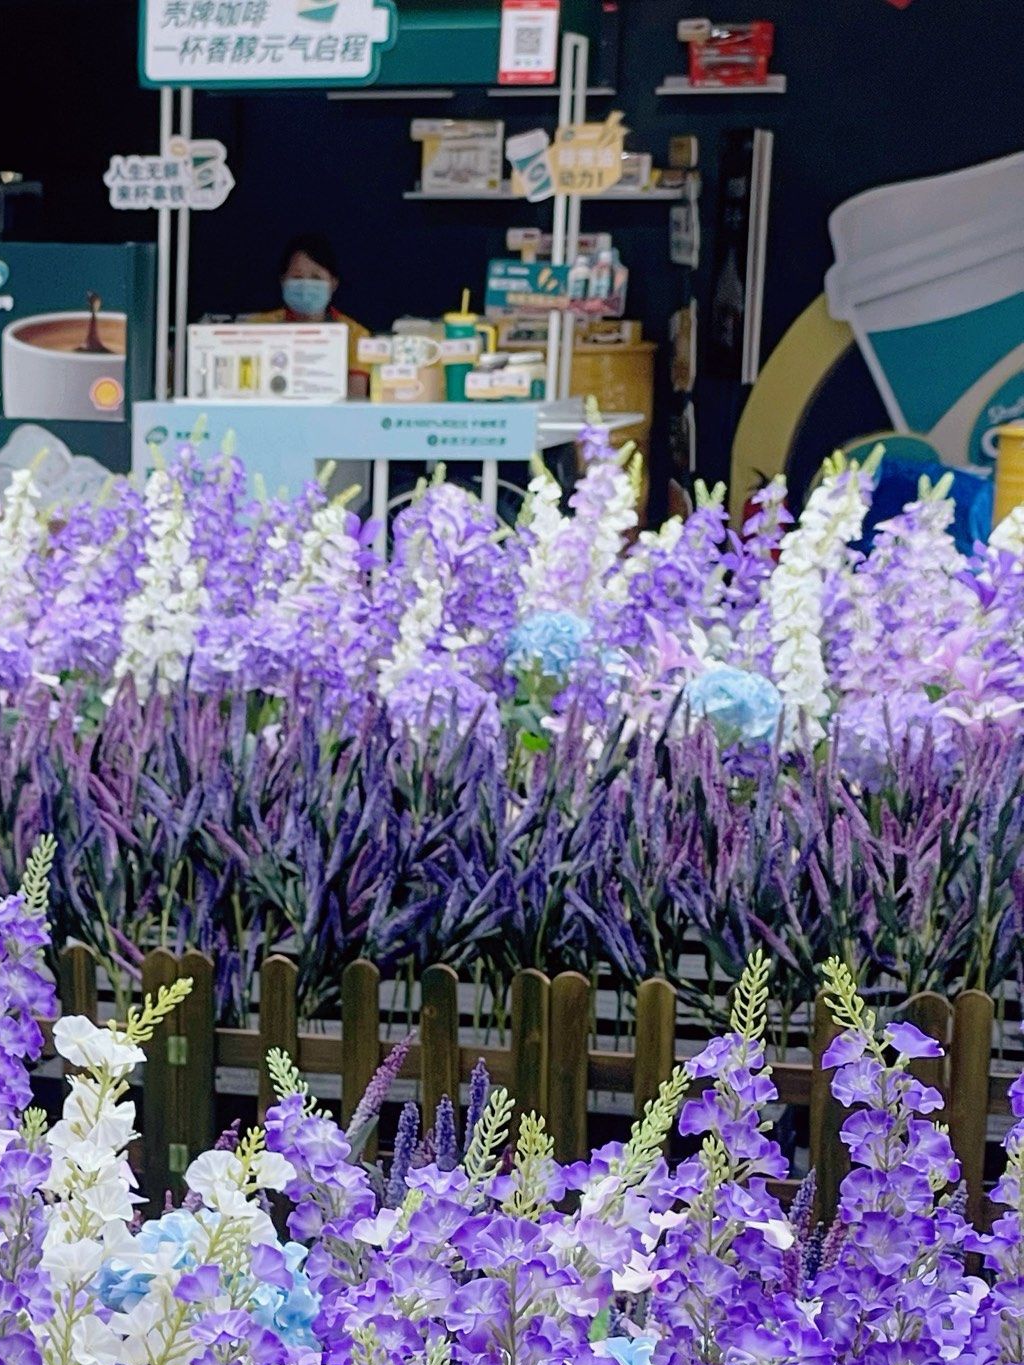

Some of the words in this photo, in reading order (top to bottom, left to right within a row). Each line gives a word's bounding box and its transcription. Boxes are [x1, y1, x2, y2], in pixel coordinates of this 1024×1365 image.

[160, 1, 269, 28] 壳牌咖啡
[154, 33, 368, 64] 一杯香醇元气启程
